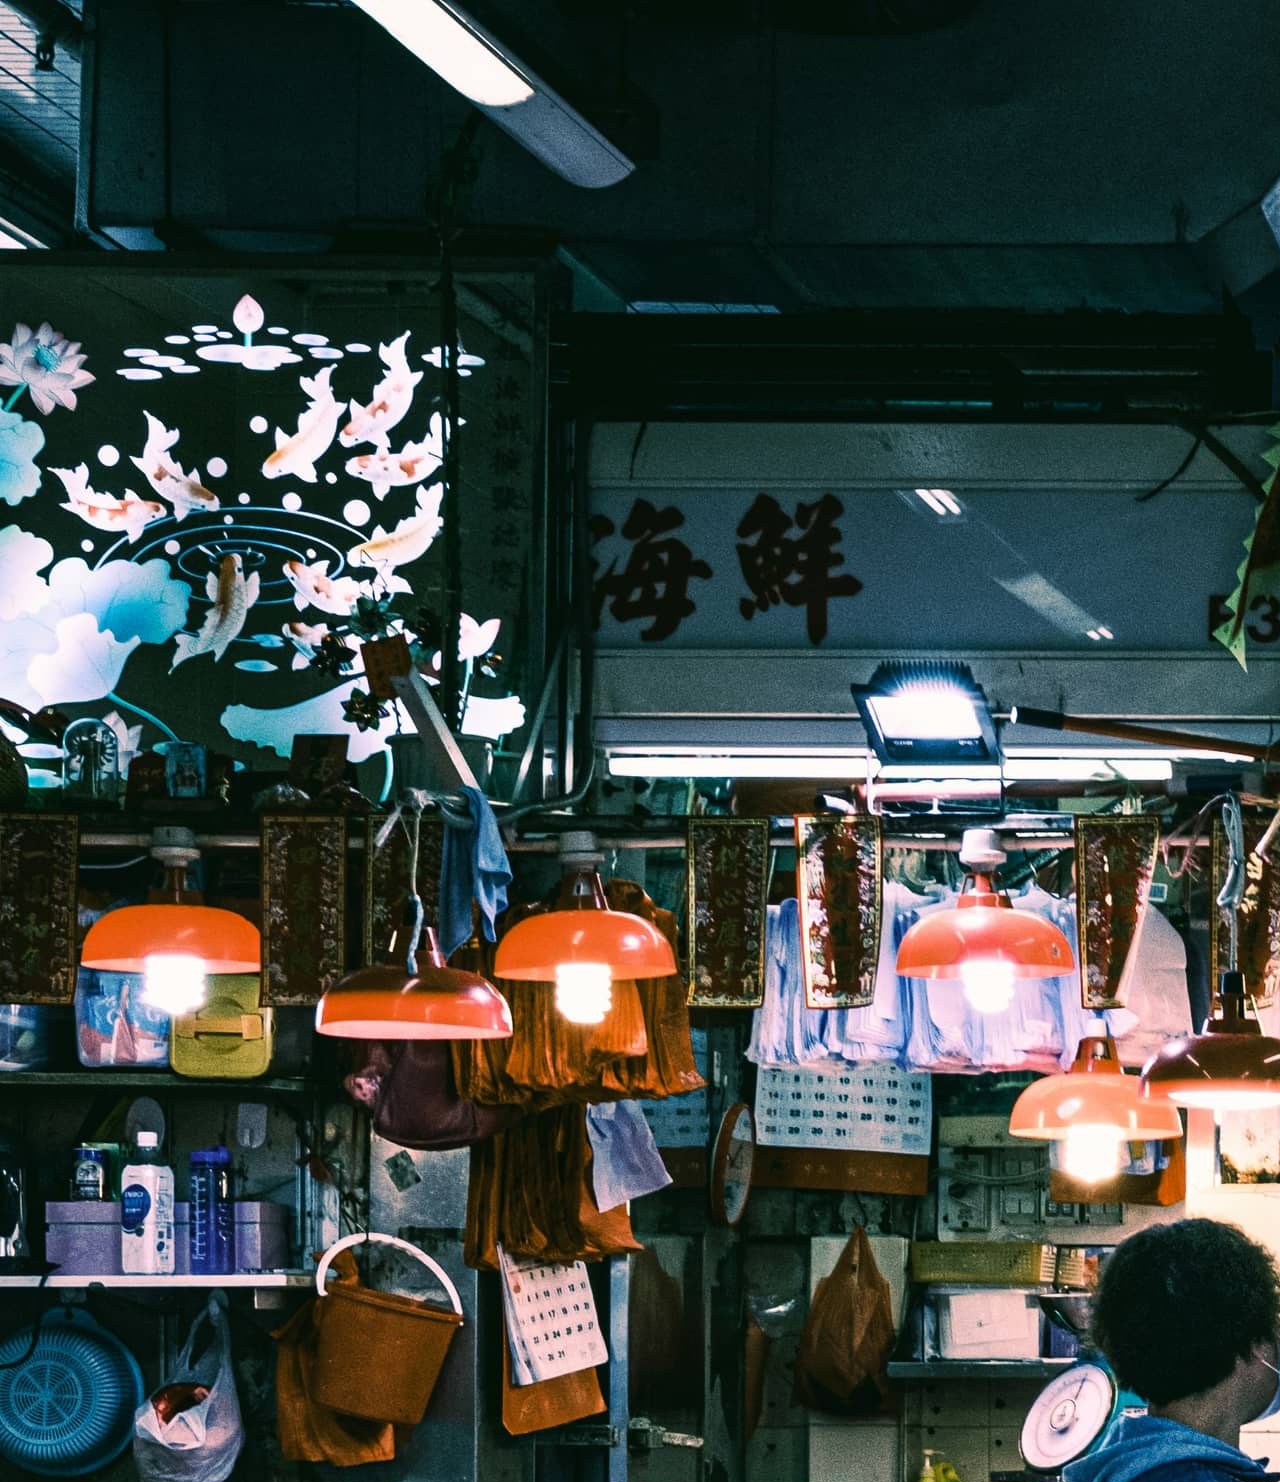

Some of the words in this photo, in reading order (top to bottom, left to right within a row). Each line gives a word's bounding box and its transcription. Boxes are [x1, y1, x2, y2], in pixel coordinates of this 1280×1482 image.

[591, 493, 863, 646] 海鮮
[771, 1074, 778, 1083] 7
[839, 1077, 850, 1085] 10
[863, 1078, 874, 1087] 11
[887, 1080, 898, 1088] 12
[768, 1091, 779, 1099] 14
[814, 1093, 825, 1101] 16
[838, 1094, 849, 1102] 17
[886, 1097, 897, 1106] 19
[909, 1099, 921, 1108] 20
[790, 1109, 801, 1117] 22
[812, 1110, 824, 1118] 23
[836, 1111, 848, 1120] 24
[860, 1113, 872, 1121] 25
[884, 1114, 896, 1123] 26
[908, 1116, 920, 1125] 27
[788, 1126, 800, 1134] 29
[811, 1127, 823, 1135] 30
[835, 1128, 847, 1136] 31
